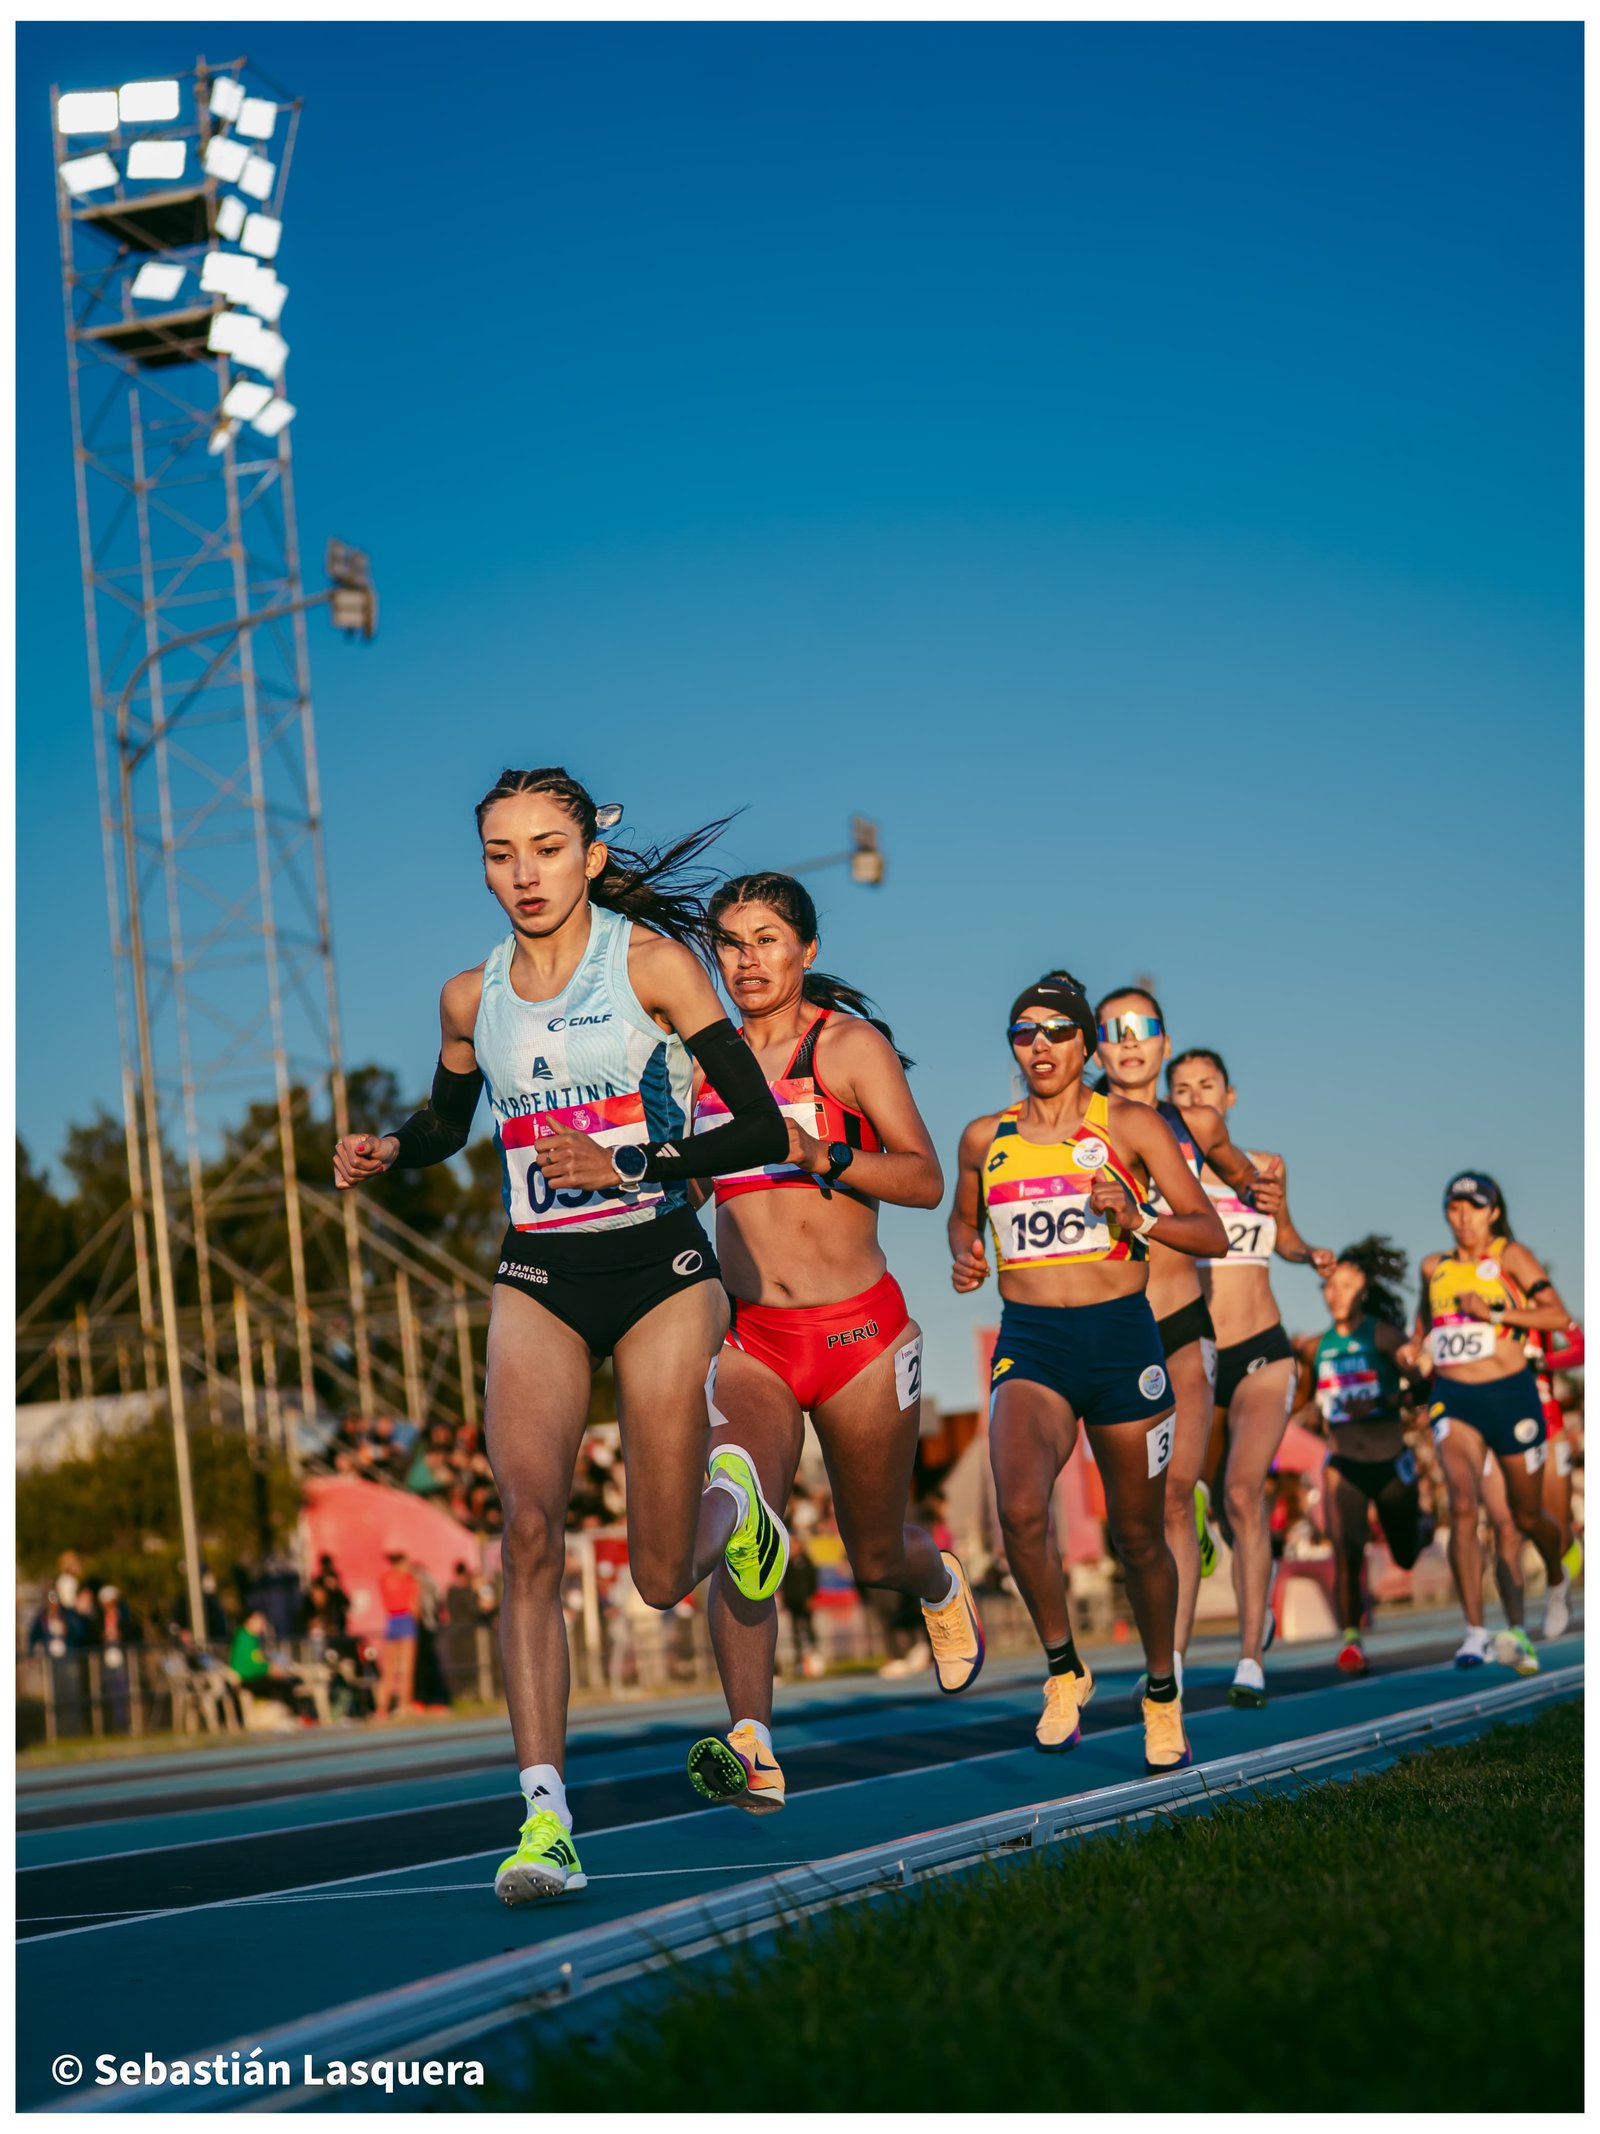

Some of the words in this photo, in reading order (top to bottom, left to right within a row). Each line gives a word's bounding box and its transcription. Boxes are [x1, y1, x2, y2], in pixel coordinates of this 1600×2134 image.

[494, 1082, 617, 1118] ARGENTINA
[1011, 1207, 1085, 1251] 196
[507, 1269, 549, 1284] SEGUROS
[510, 1262, 548, 1276] SANCOR
[827, 1319, 879, 1349] PERÚ
[1438, 1332, 1483, 1359] 205
[1157, 1431, 1169, 1463] 3
